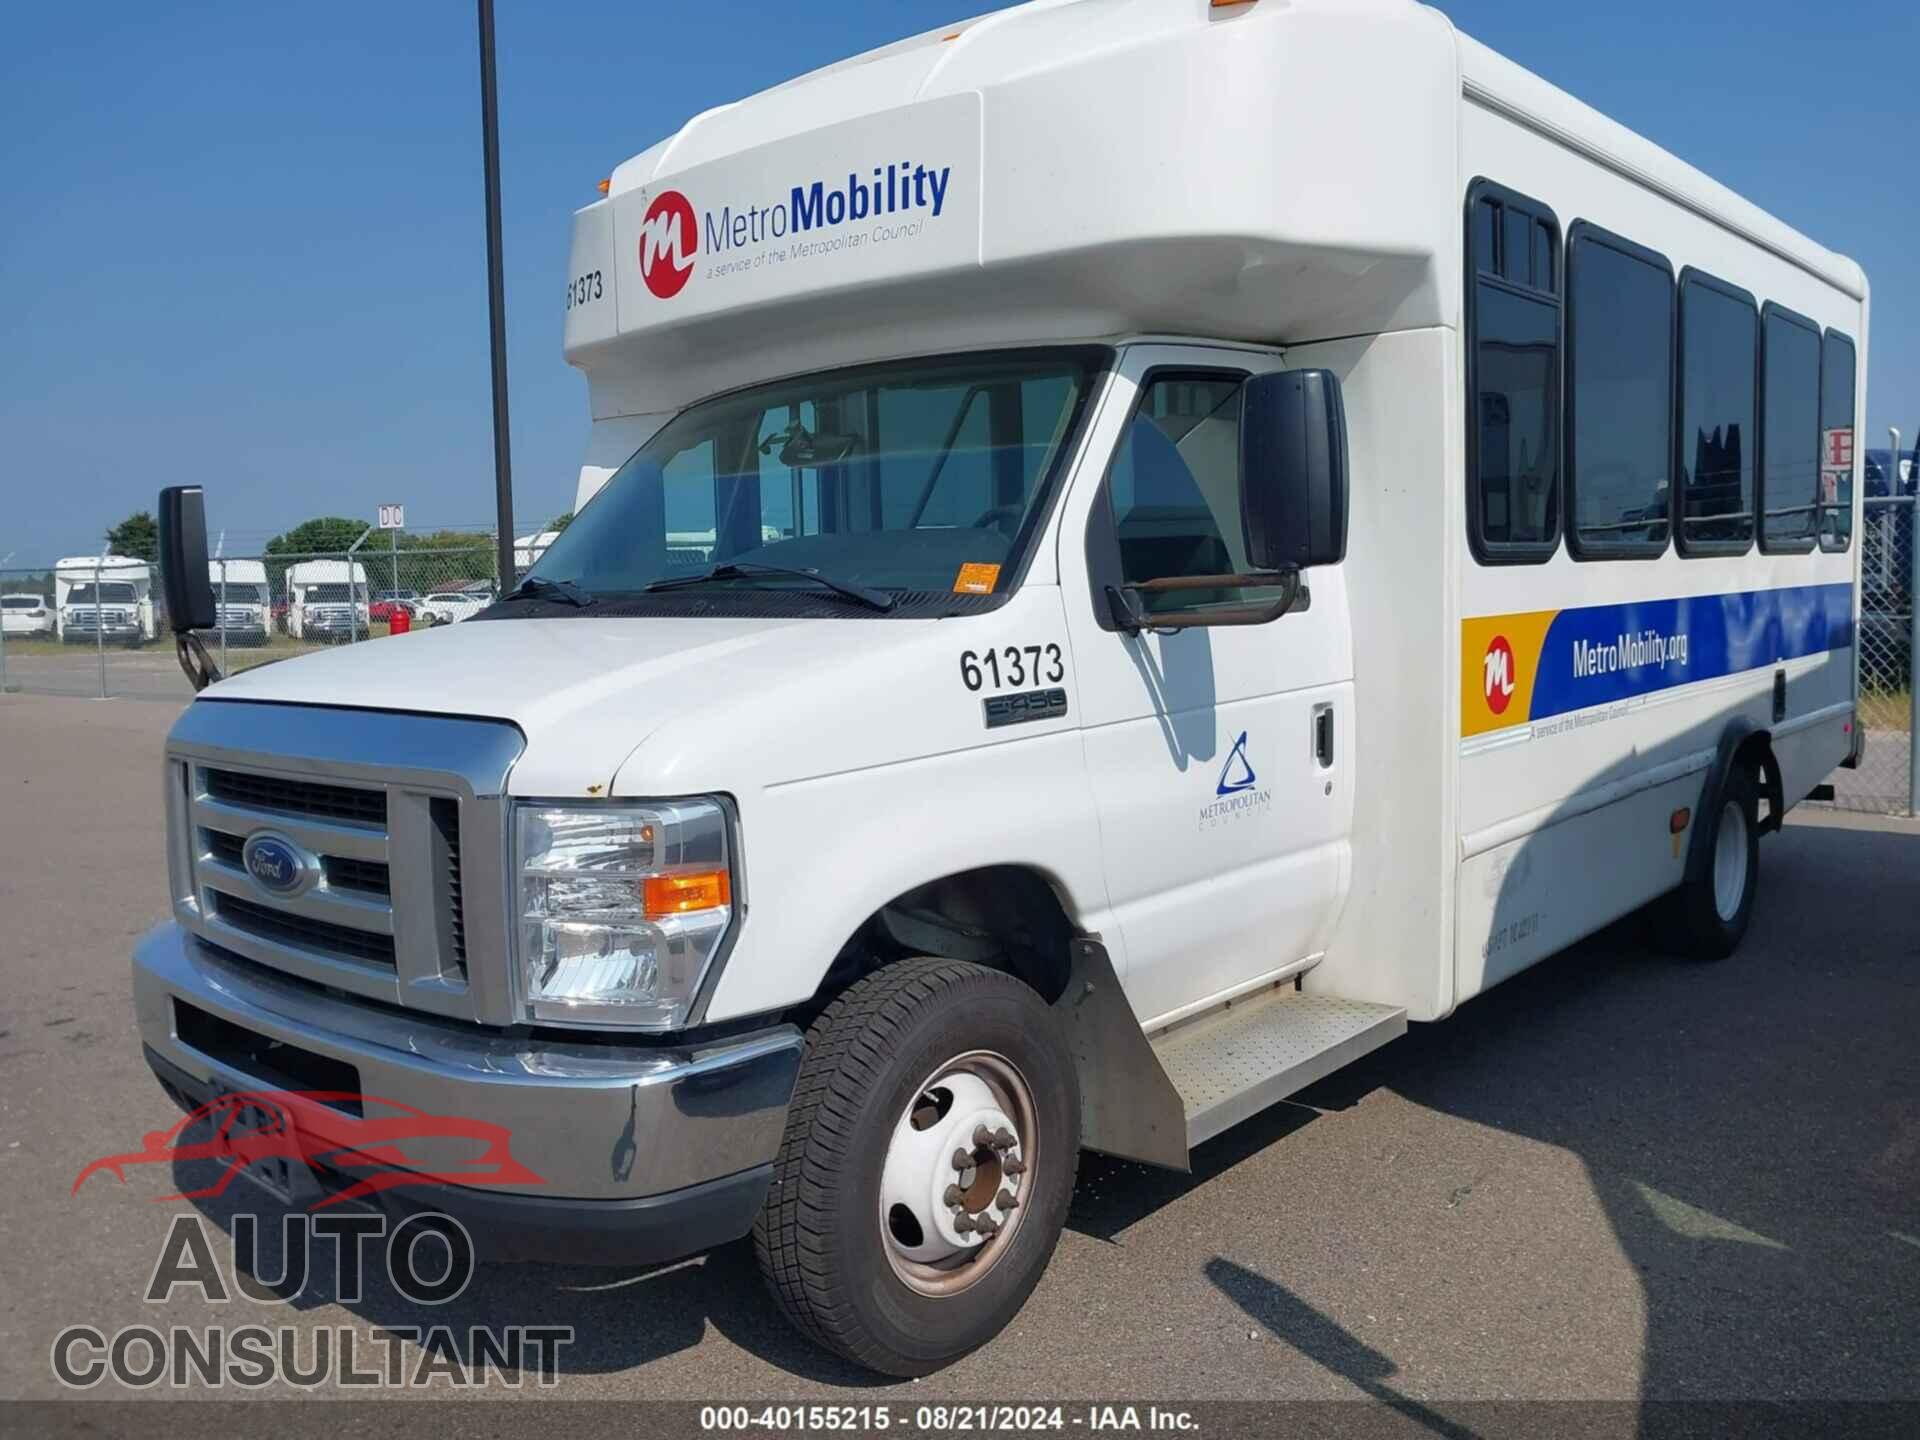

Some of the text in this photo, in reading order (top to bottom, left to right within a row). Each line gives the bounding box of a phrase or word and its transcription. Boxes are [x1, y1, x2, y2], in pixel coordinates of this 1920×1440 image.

[705, 161, 950, 255] MetroMobility
[706, 220, 923, 279] a service of the Metropolitan Council
[566, 270, 602, 310] 61373
[960, 643, 1065, 691] 61373
[1573, 630, 1688, 679] MetroMobility.org
[1199, 788, 1272, 821] METROPOLITAN
